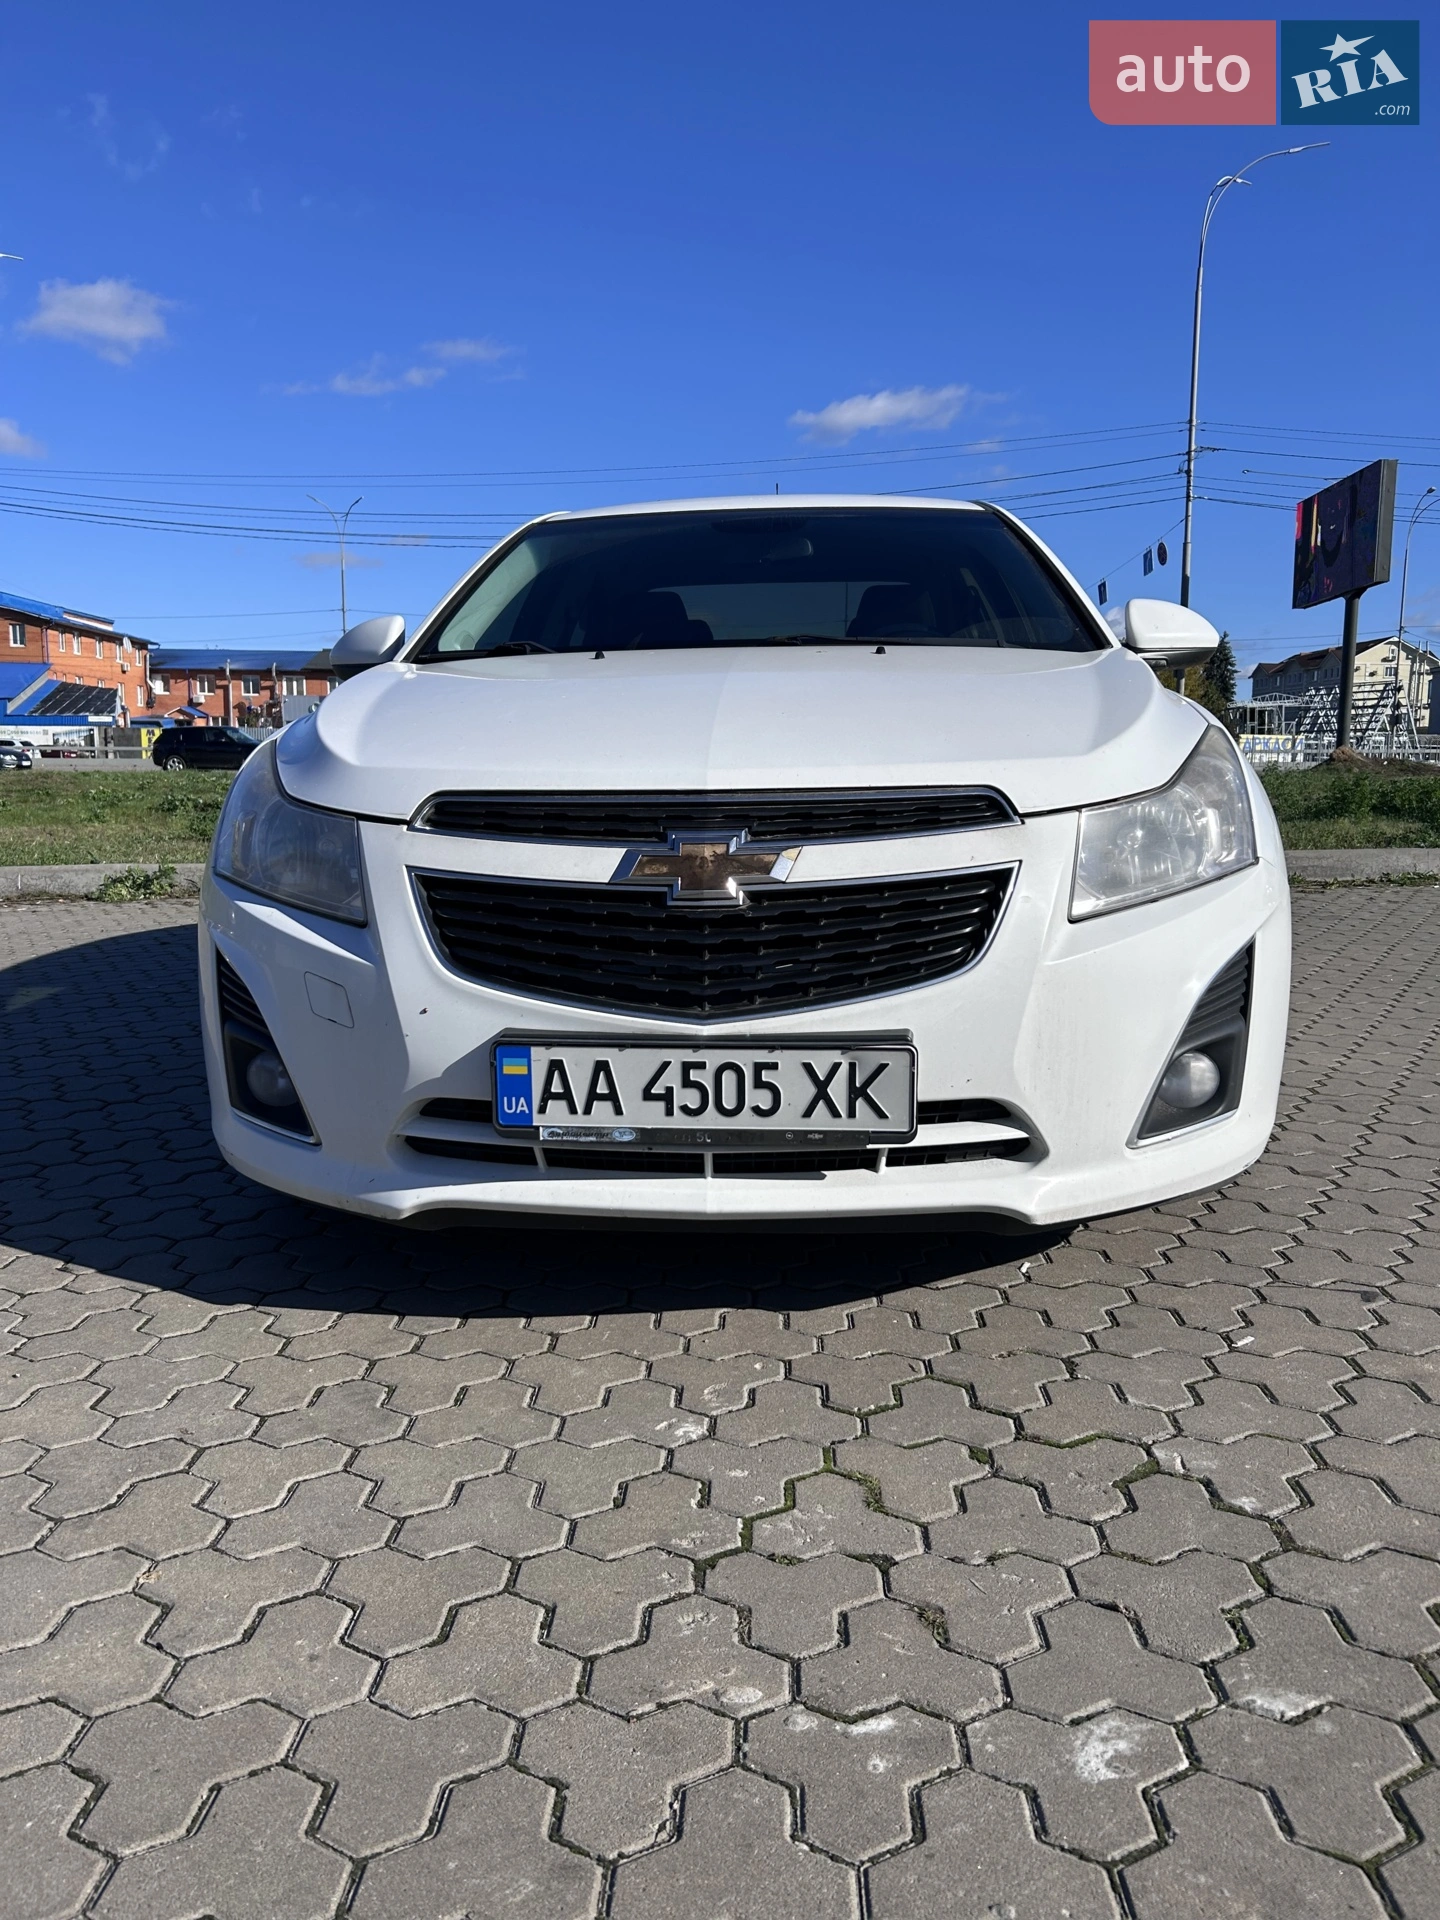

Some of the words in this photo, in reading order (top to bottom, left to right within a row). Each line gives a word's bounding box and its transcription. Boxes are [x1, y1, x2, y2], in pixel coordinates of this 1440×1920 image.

[504, 1097, 529, 1114] UA
[537, 1059, 625, 1116] AA
[643, 1060, 781, 1118] 4505
[801, 1061, 890, 1119] XK
